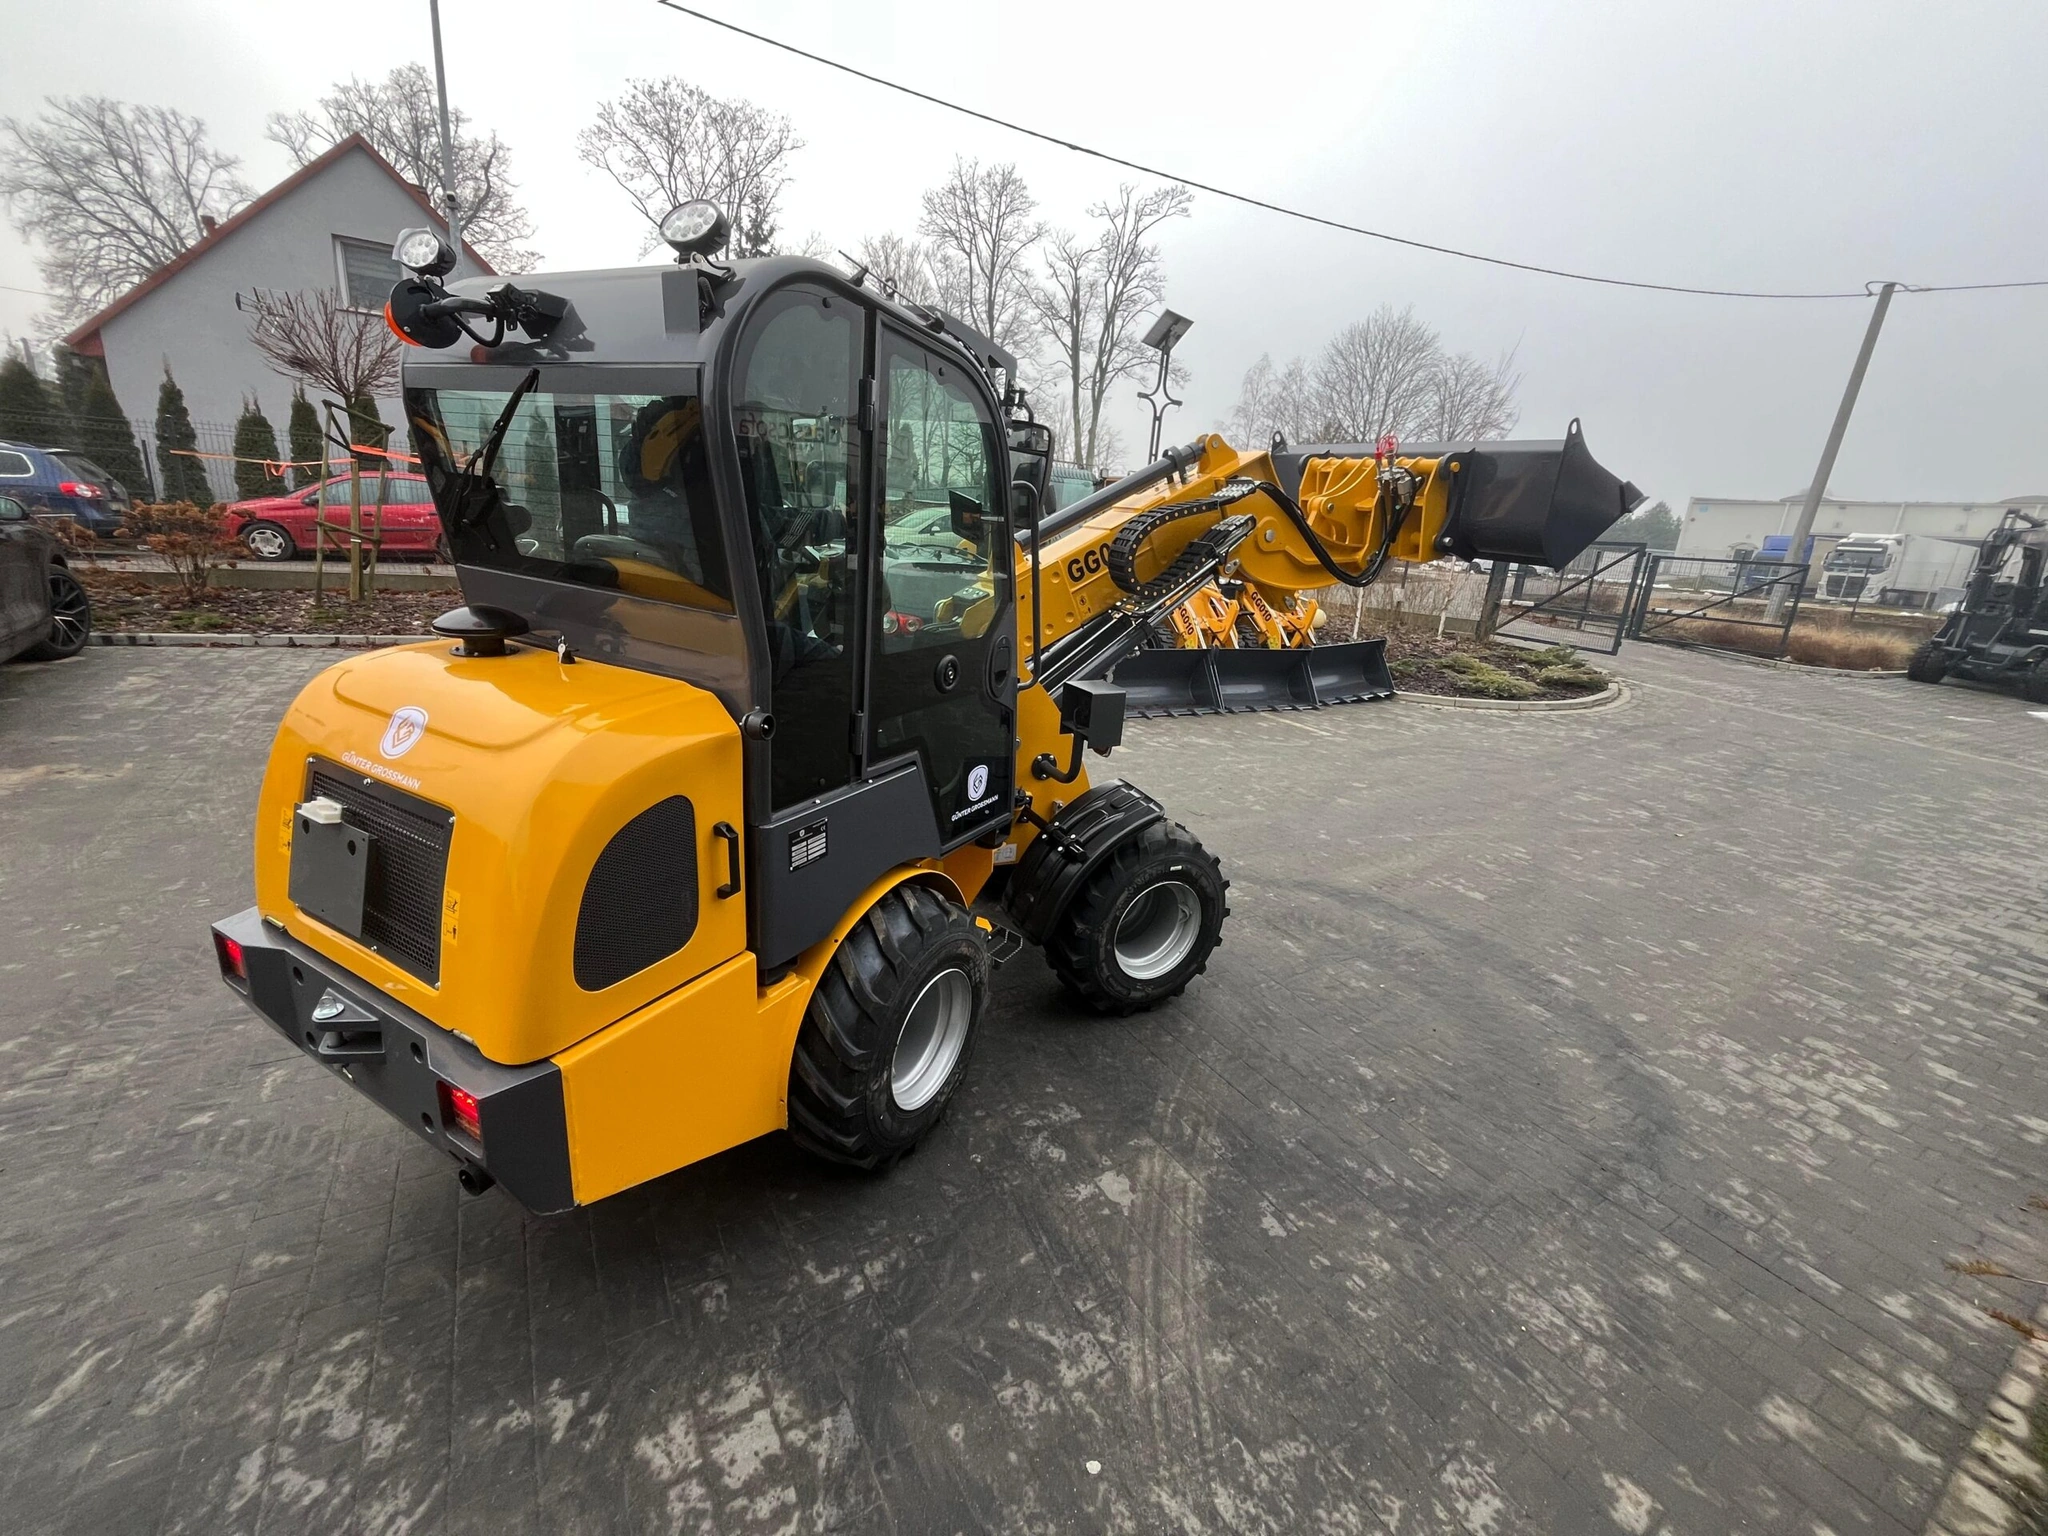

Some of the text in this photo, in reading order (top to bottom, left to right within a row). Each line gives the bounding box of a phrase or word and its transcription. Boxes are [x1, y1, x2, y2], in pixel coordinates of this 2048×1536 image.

[1179, 606, 1195, 636] G010
[1251, 591, 1272, 622] GG010
[341, 751, 421, 790] GÜNTER GROSSMANN
